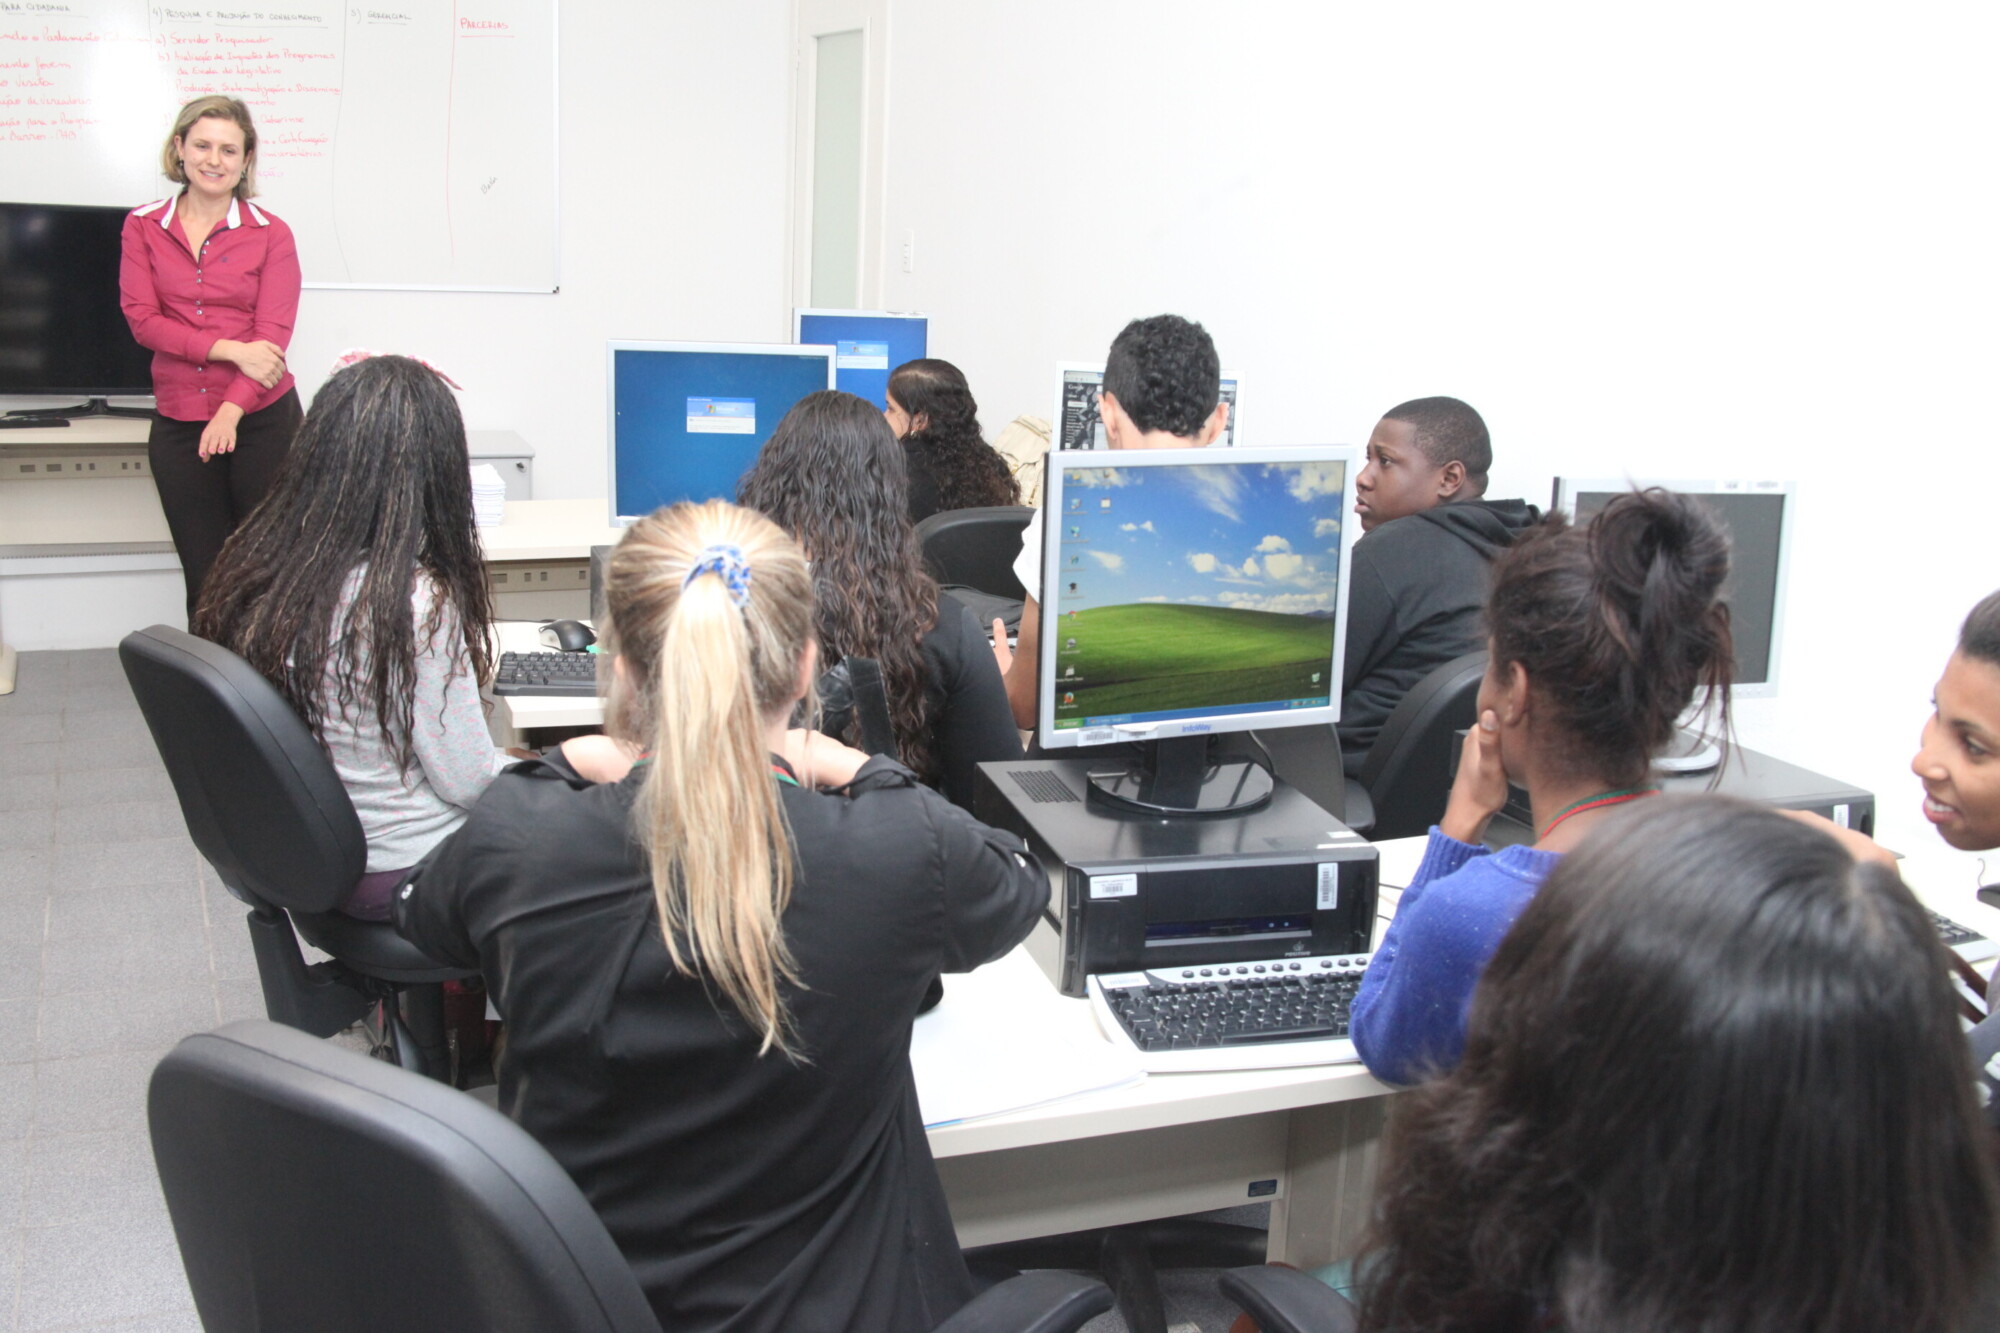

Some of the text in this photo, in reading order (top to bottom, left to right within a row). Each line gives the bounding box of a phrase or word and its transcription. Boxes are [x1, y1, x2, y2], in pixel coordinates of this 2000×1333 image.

[368, 11, 412, 20] GERENCIAL
[460, 17, 509, 29] PARCERIAS
[170, 32, 210, 44] Servidor
[283, 48, 336, 62] Programas
[1182, 724, 1211, 732] InfoWay
